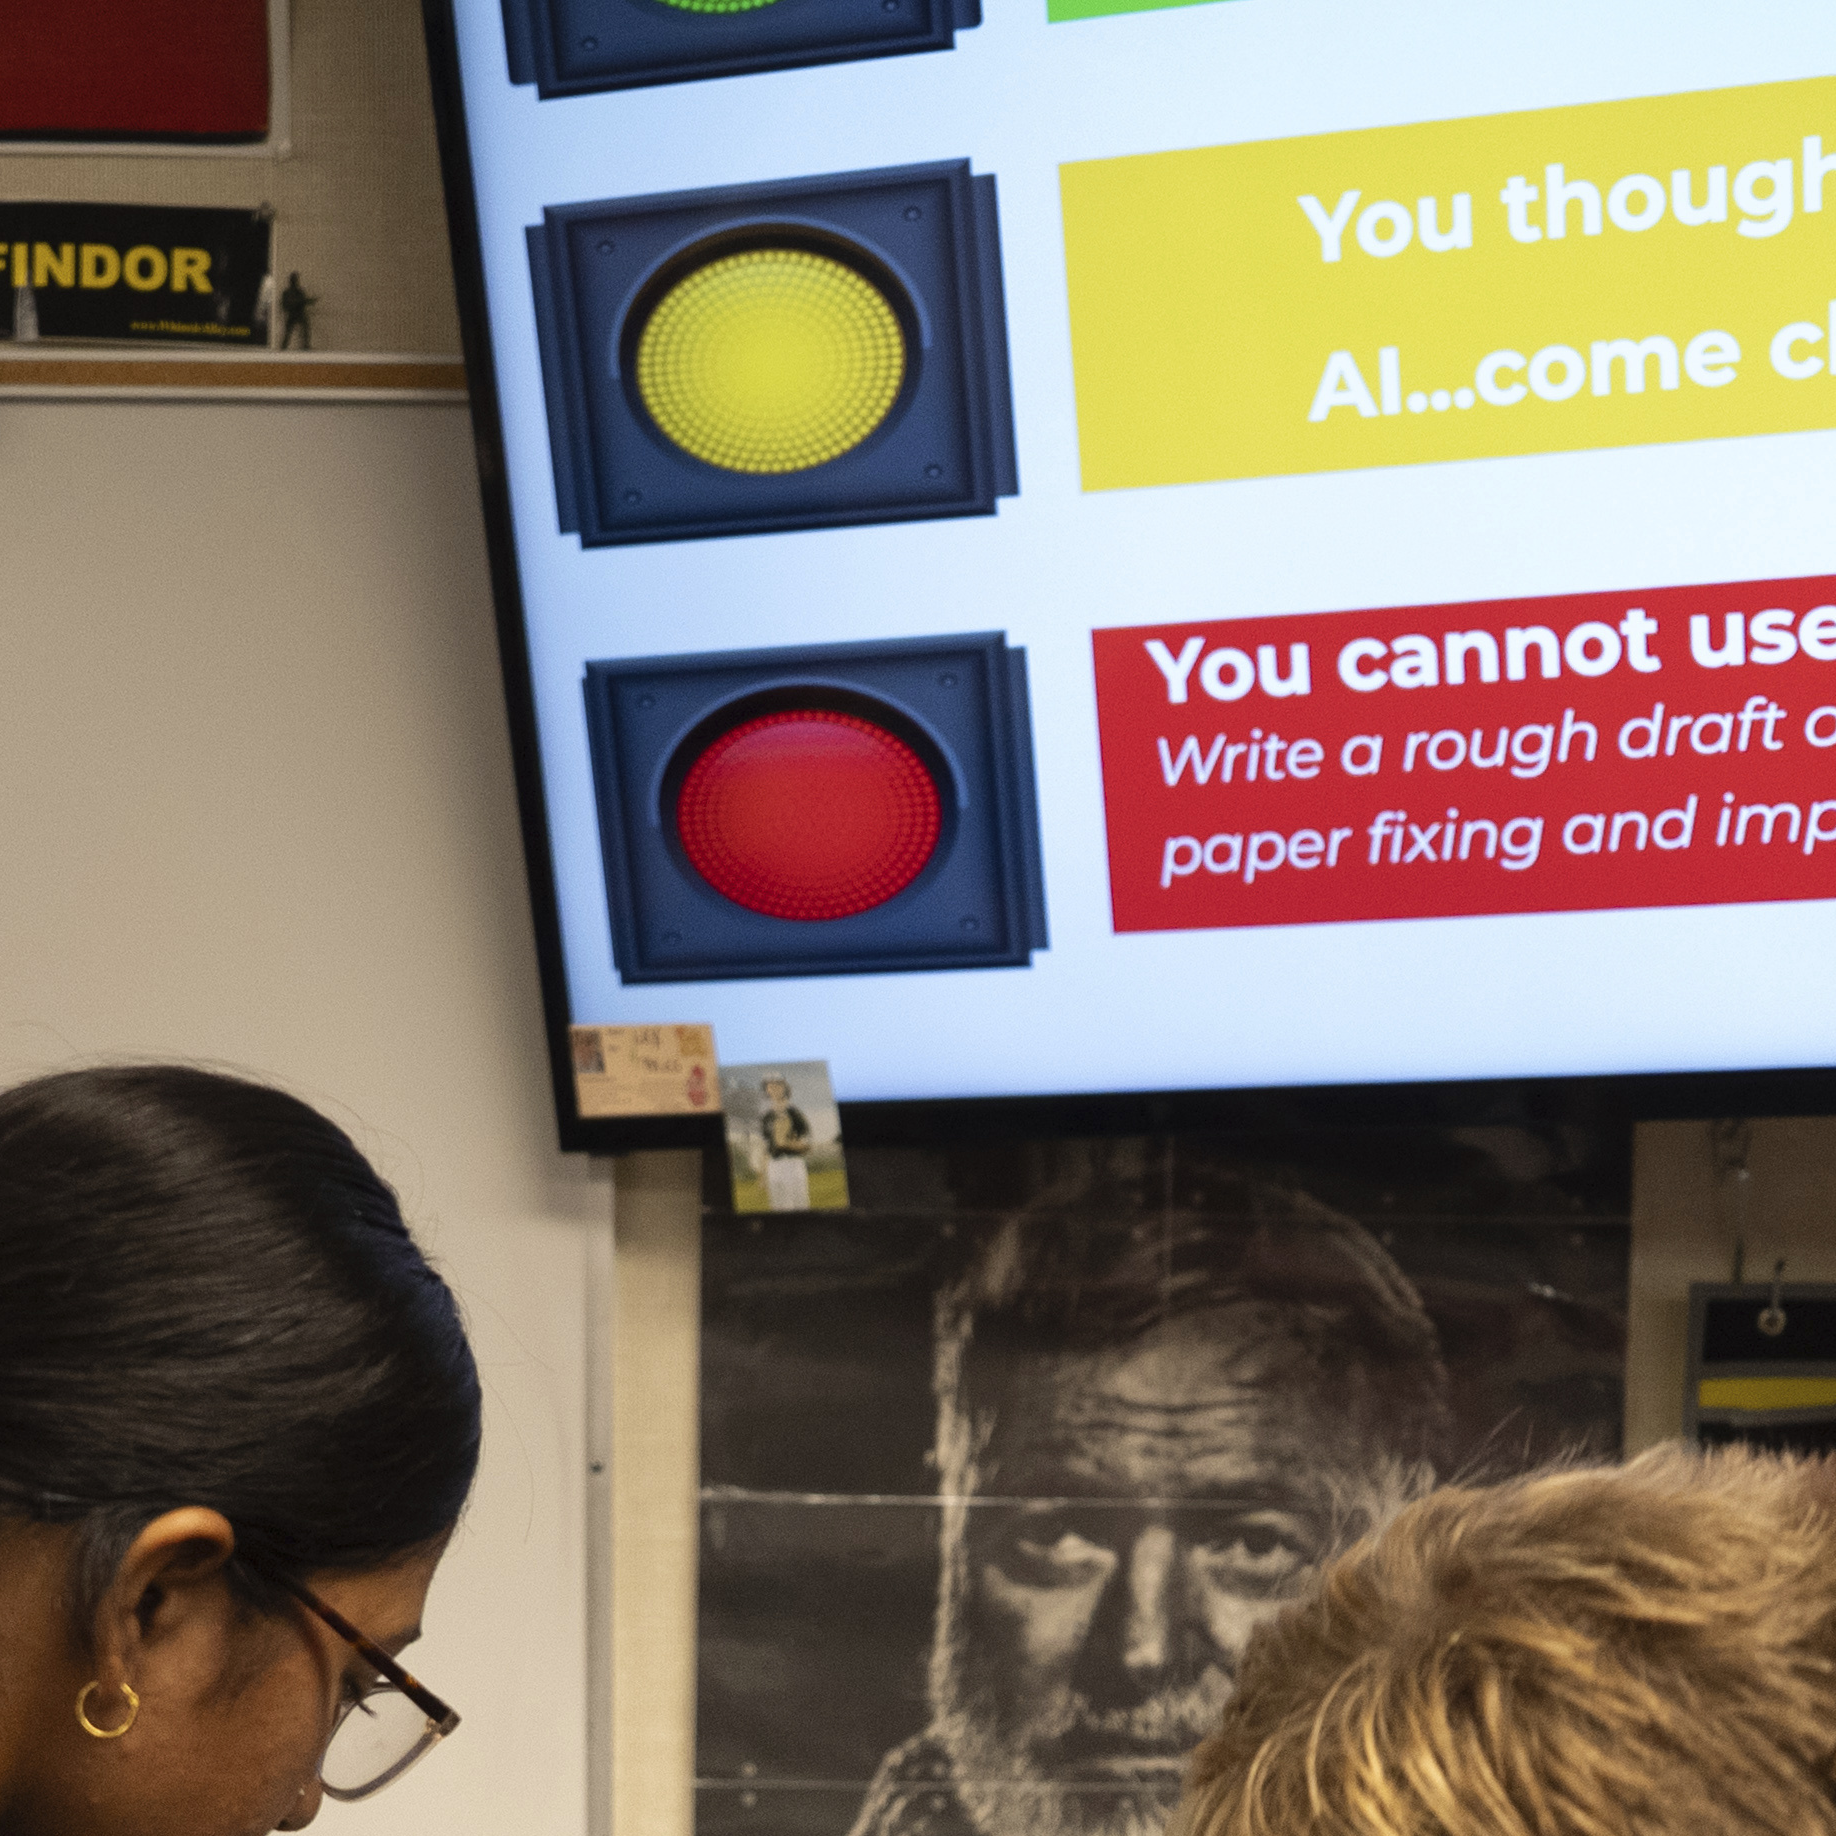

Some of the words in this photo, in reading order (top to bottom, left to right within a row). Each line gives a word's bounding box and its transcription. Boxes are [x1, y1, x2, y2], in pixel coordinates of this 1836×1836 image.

[1297, 190, 1473, 262] You
[1308, 330, 1741, 422] AI...come
[1145, 637, 1311, 703] You
[1338, 608, 1661, 693] cannot
[1158, 729, 1324, 786] Write
[1341, 734, 1383, 775] a
[1404, 708, 1598, 778] rough
[1619, 695, 1787, 758] draft
[1162, 828, 1353, 887] paper
[1369, 808, 1543, 872] fixing
[1563, 794, 1698, 854] and
